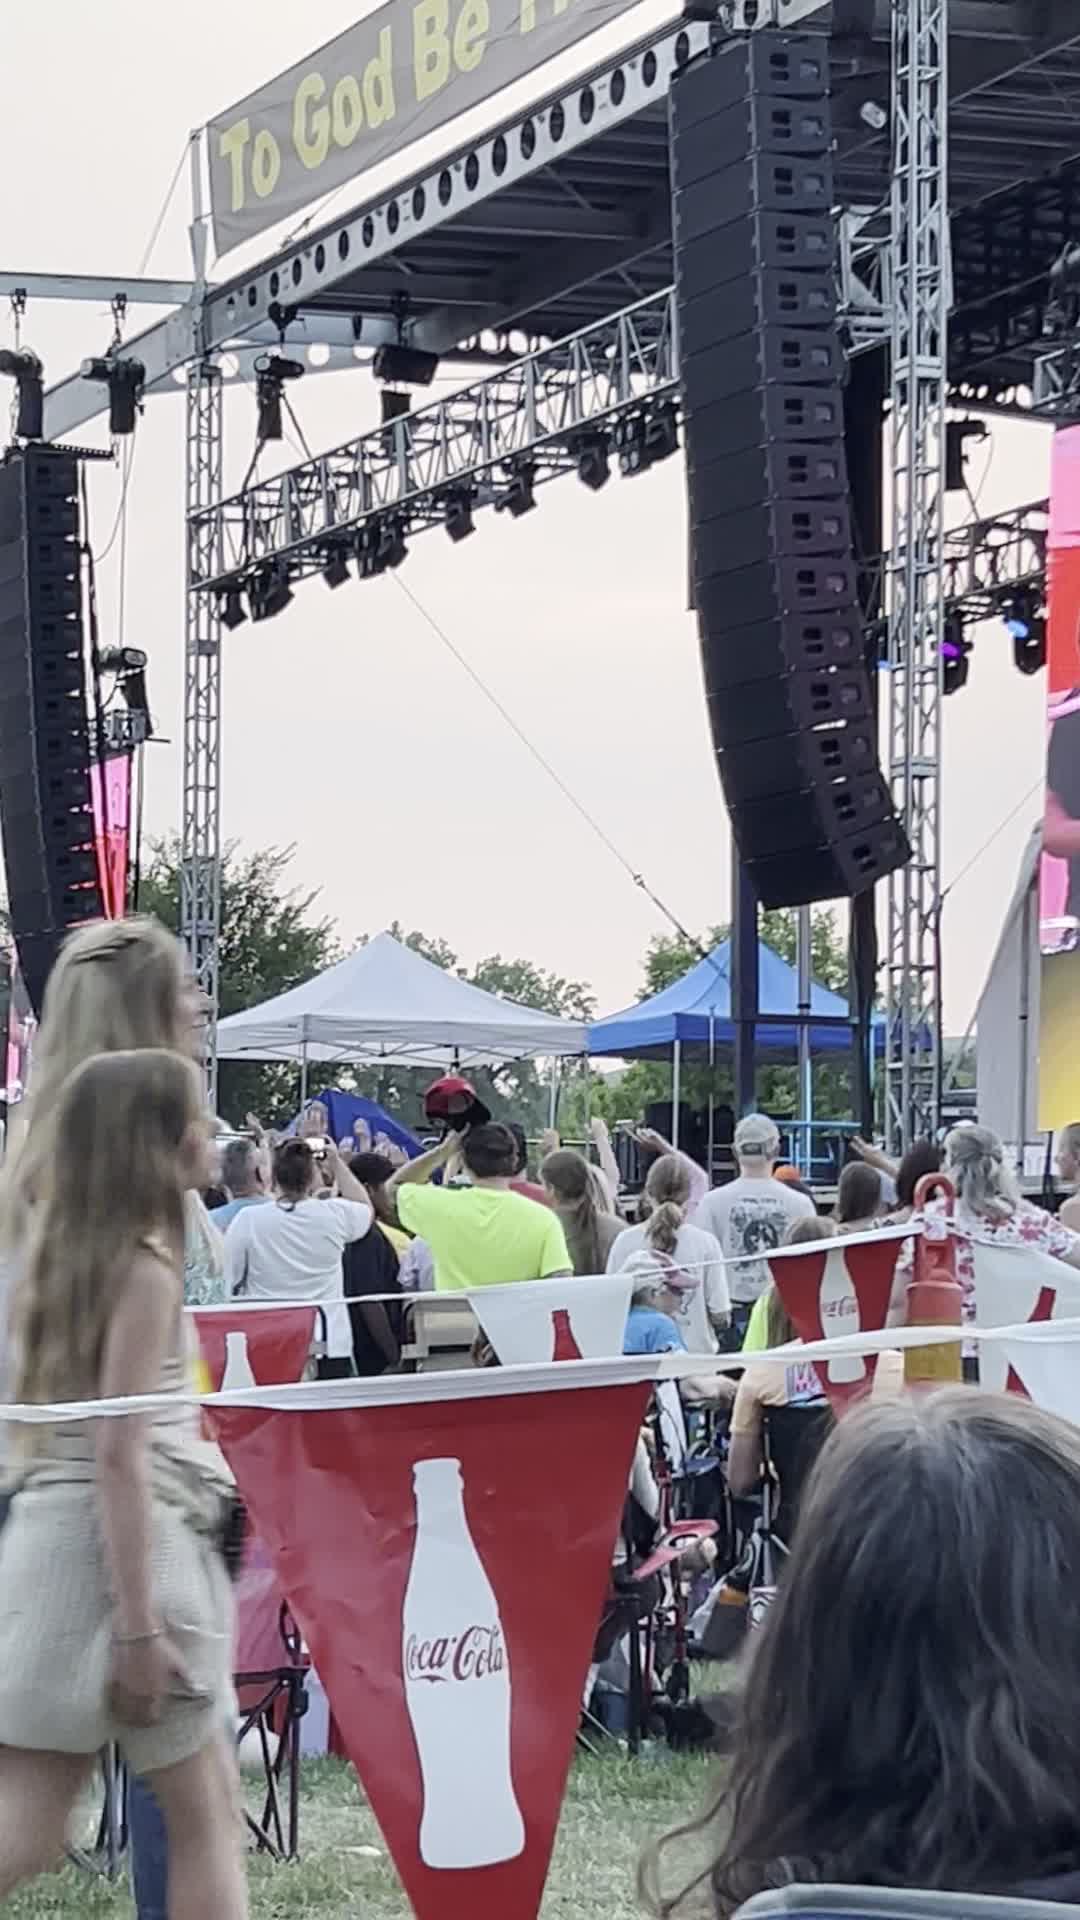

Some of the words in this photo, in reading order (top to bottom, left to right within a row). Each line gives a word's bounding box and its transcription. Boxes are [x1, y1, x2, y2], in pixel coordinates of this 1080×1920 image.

[219, 117, 281, 213] To
[292, 26, 396, 170] God
[413, 0, 489, 101] Be
